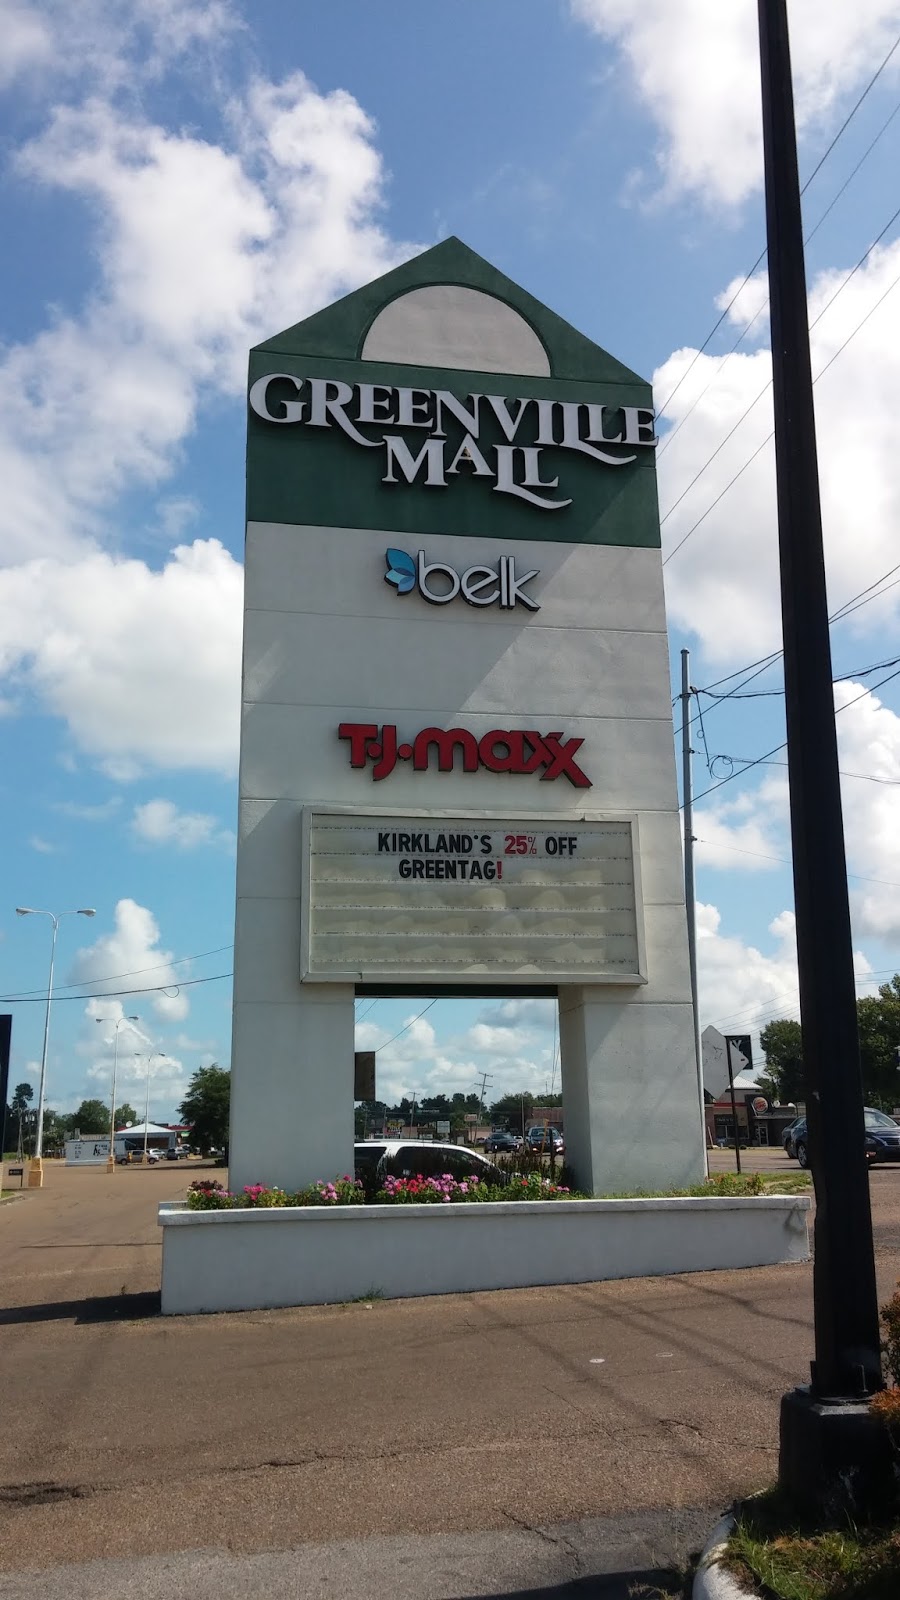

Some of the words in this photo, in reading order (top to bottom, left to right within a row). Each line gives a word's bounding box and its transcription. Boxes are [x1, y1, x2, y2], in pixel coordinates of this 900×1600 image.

[249, 373, 659, 466] GREENVILLE
[381, 432, 573, 510] MALL
[418, 549, 541, 612] belk
[378, 832, 492, 855] KIRKLAND'S
[504, 835, 537, 855] 25%
[545, 836, 578, 856] OFF
[399, 859, 503, 880] GREENTAG!
